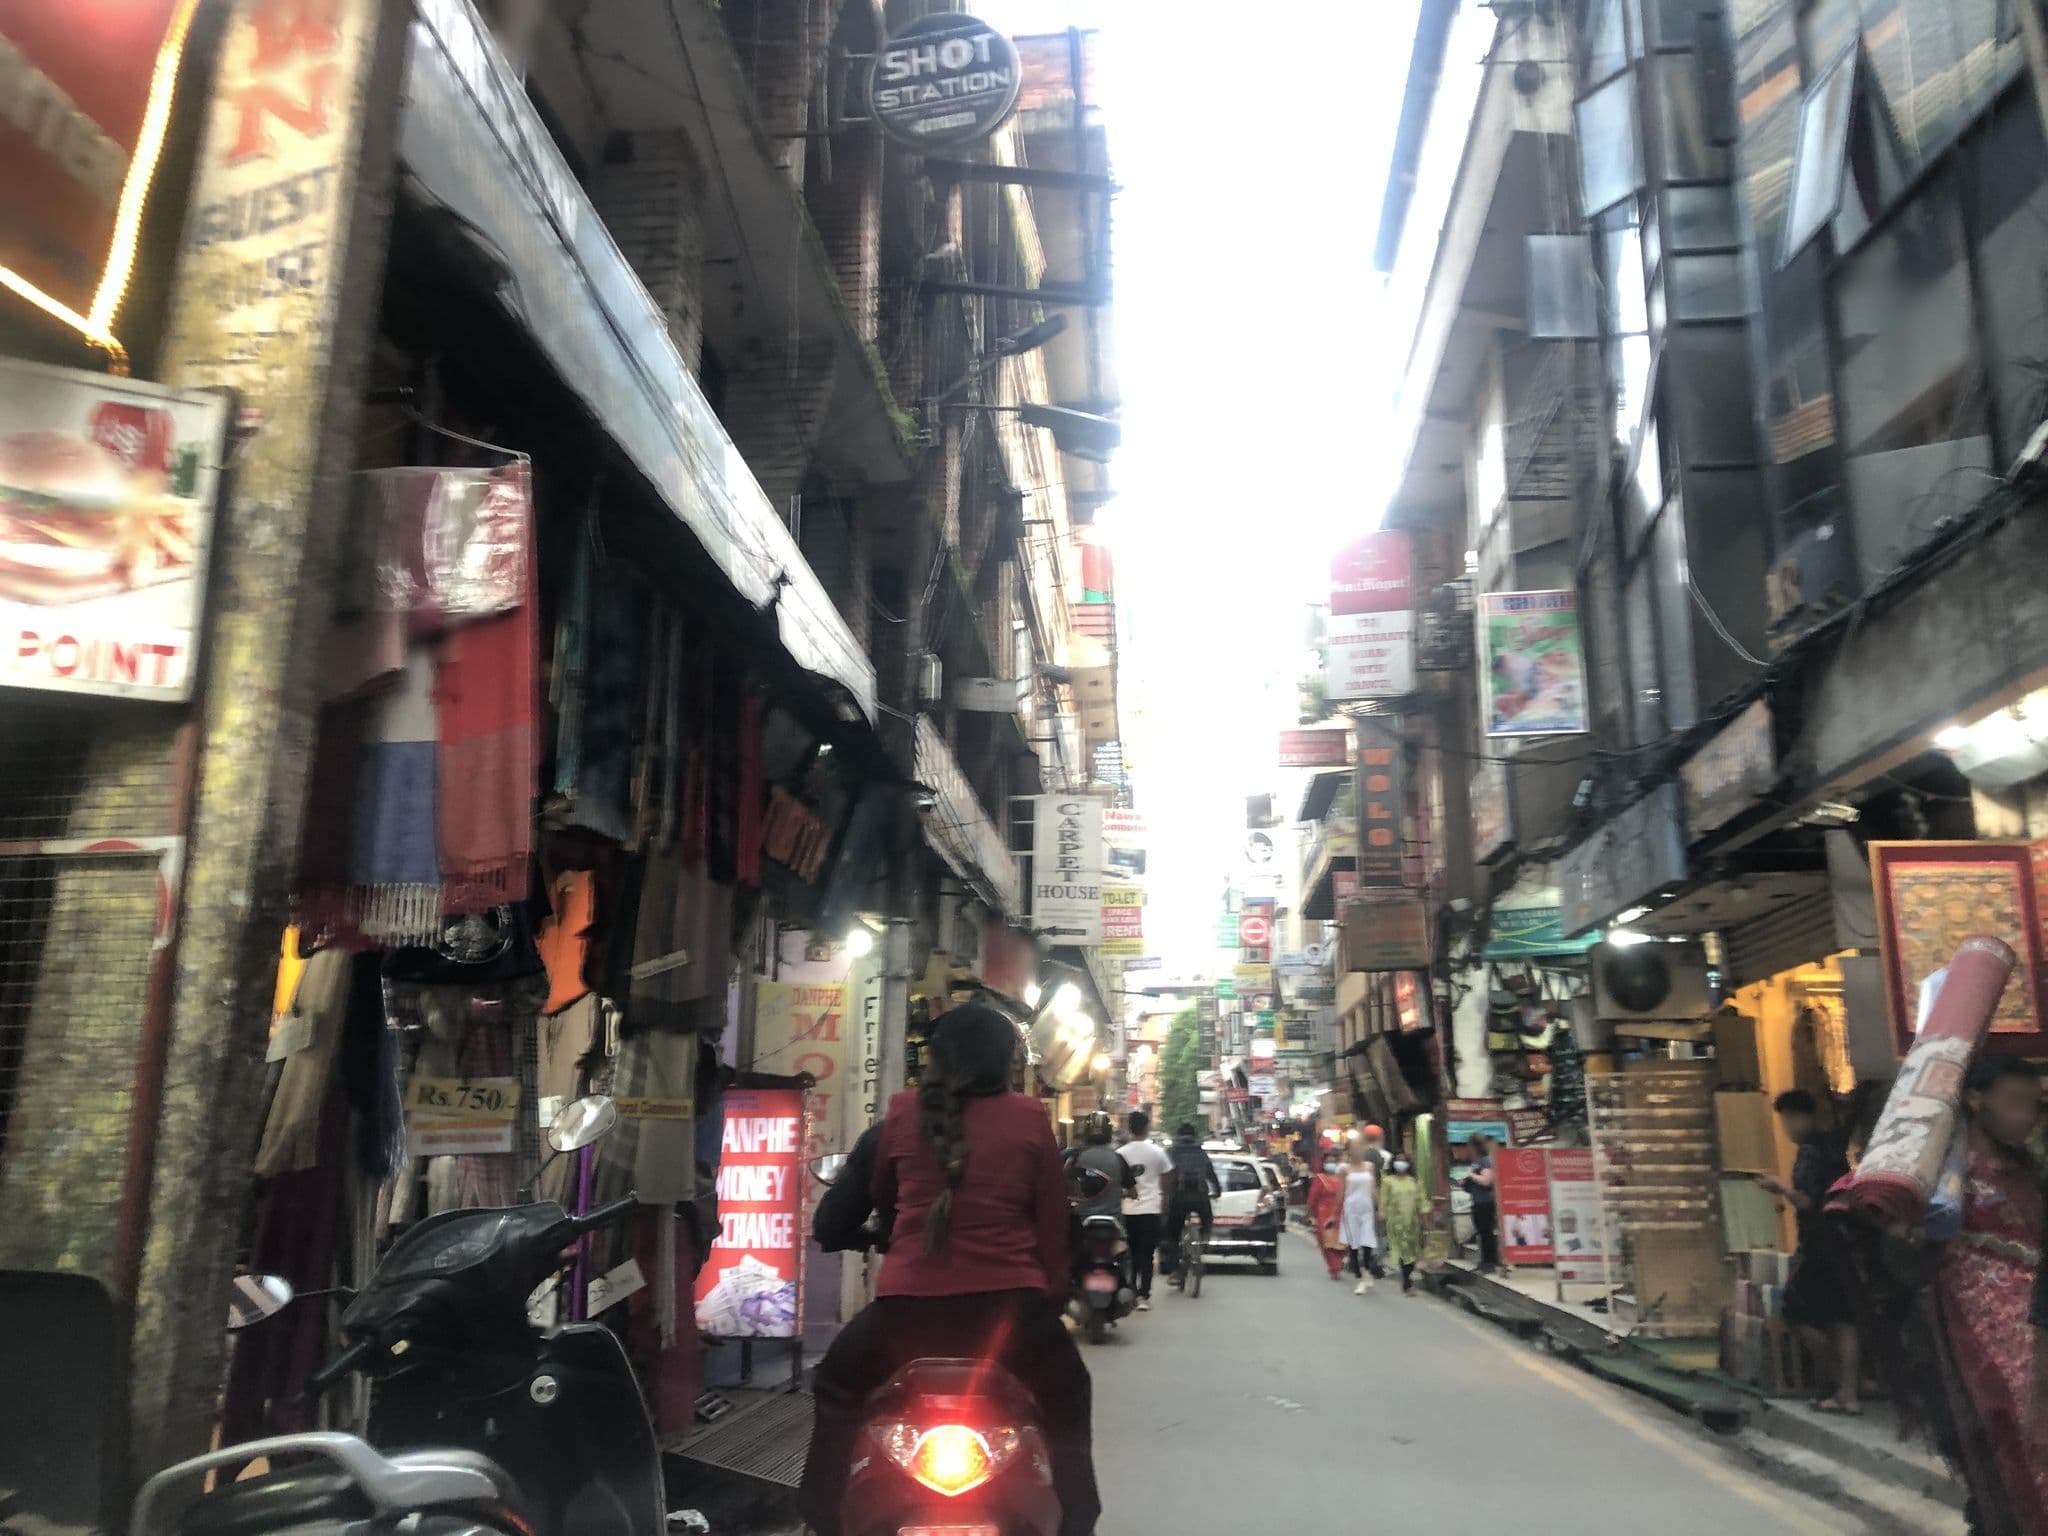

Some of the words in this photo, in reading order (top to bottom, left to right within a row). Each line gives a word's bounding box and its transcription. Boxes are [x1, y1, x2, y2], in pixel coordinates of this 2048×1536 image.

[880, 32, 997, 82] SHOT
[877, 67, 1011, 108] STATION
[17, 630, 184, 686] POINT
[1056, 803, 1083, 882] CARPET
[1036, 884, 1100, 900] HOUSE
[1102, 891, 1137, 905] TO-LET
[791, 987, 842, 1007] DANPHE
[721, 1117, 800, 1153] ANPHE
